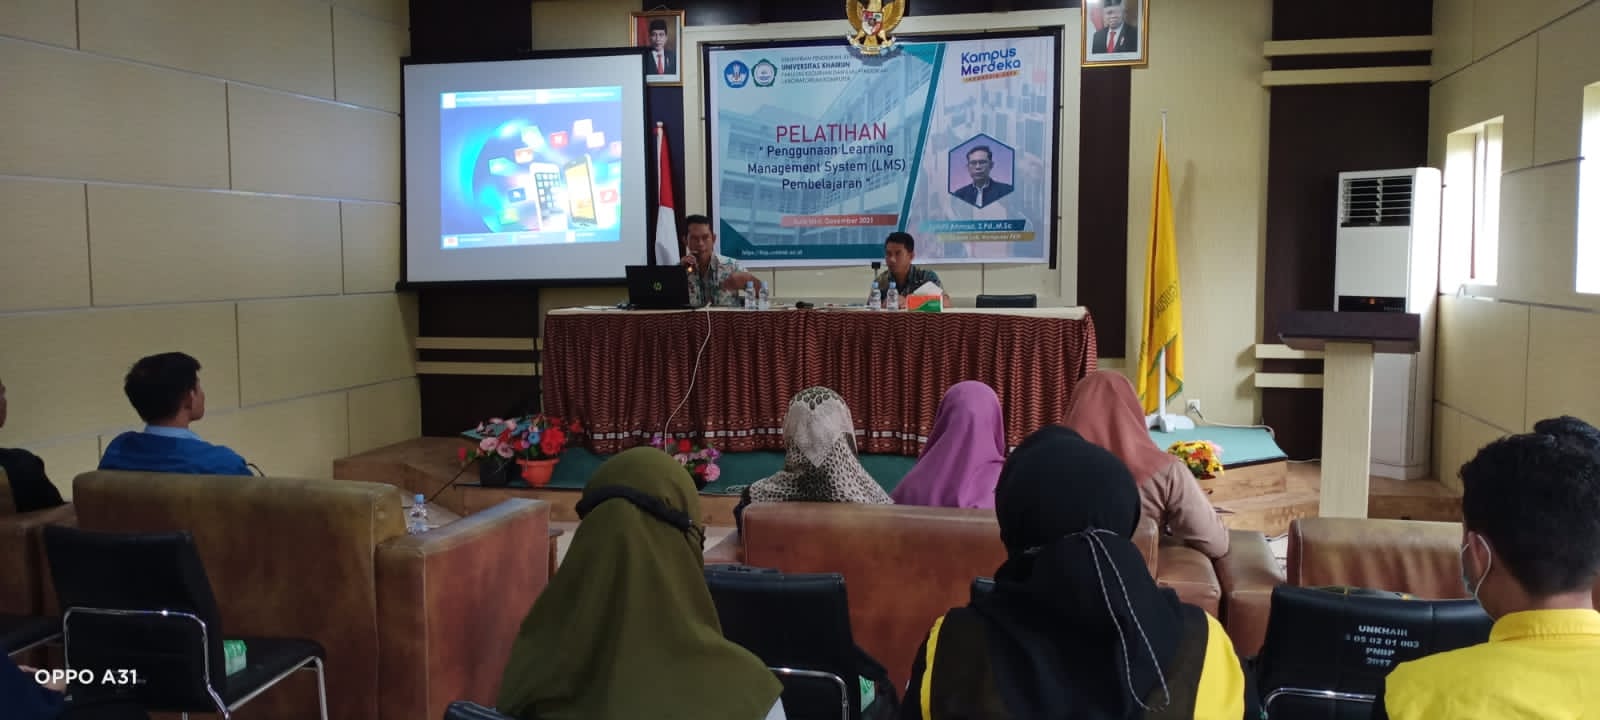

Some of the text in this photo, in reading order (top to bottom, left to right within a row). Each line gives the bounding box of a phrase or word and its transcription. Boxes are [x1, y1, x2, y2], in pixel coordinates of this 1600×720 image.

[961, 48, 1016, 64] Kampus
[781, 61, 850, 71] UNIVERSITAS KHAIRUN
[961, 59, 1021, 76] Merdeka
[776, 122, 887, 143] PELATIHAN
[767, 145, 837, 159] Penggunaan
[841, 144, 894, 155] Learning
[748, 159, 906, 175] Management System (LMS)
[782, 178, 862, 191] Pembelajaran
[1358, 625, 1408, 637] UNKHAIR
[1369, 637, 1382, 645] 02
[1385, 639, 1397, 647] 01
